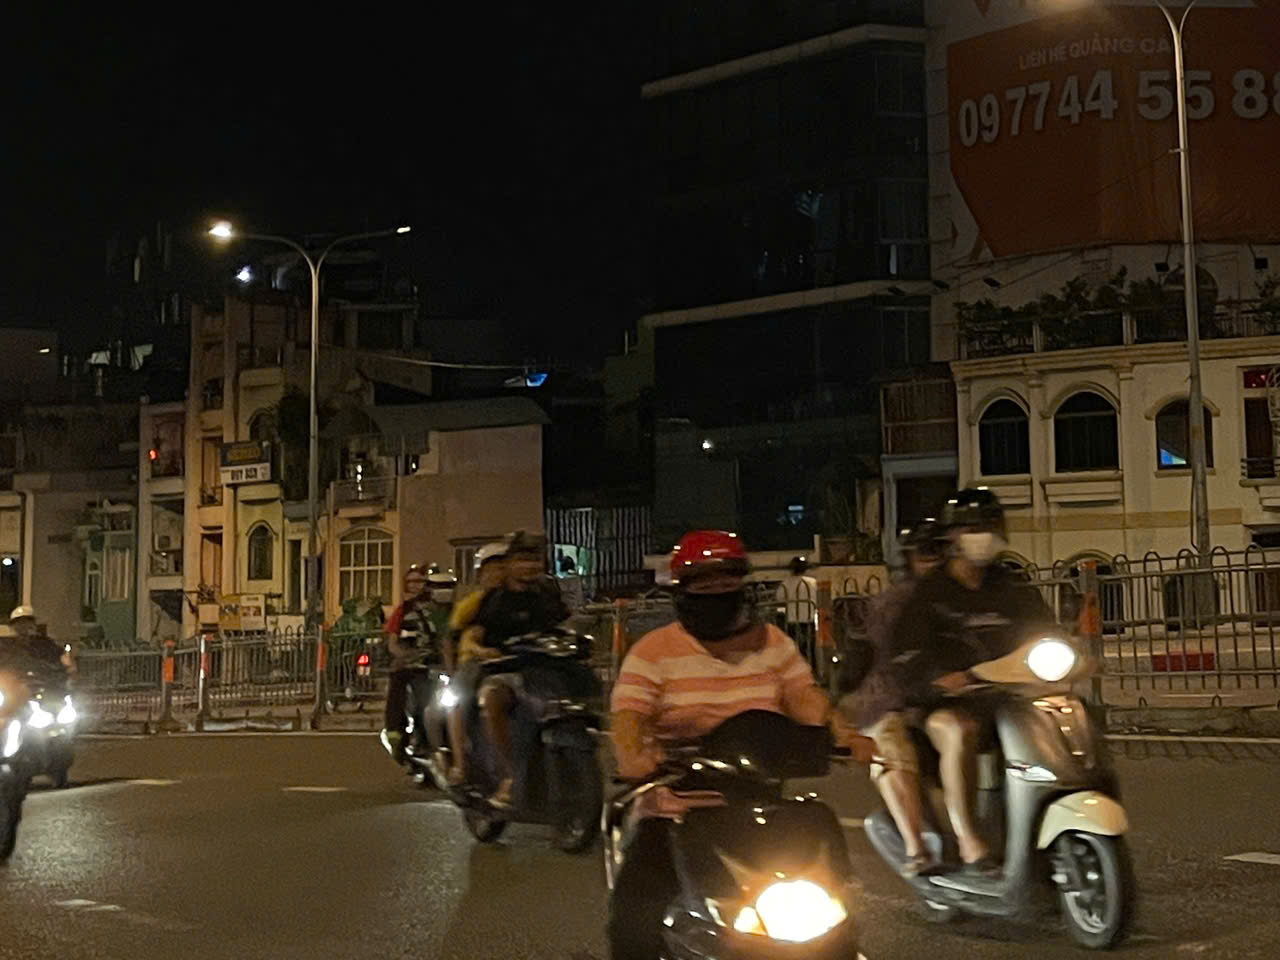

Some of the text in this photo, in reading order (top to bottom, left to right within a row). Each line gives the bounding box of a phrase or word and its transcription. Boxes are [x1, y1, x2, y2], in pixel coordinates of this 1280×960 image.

[959, 93, 1000, 147] 09
[1005, 81, 1050, 136] 77
[1057, 69, 1119, 124] 44
[1136, 69, 1215, 121] 55
